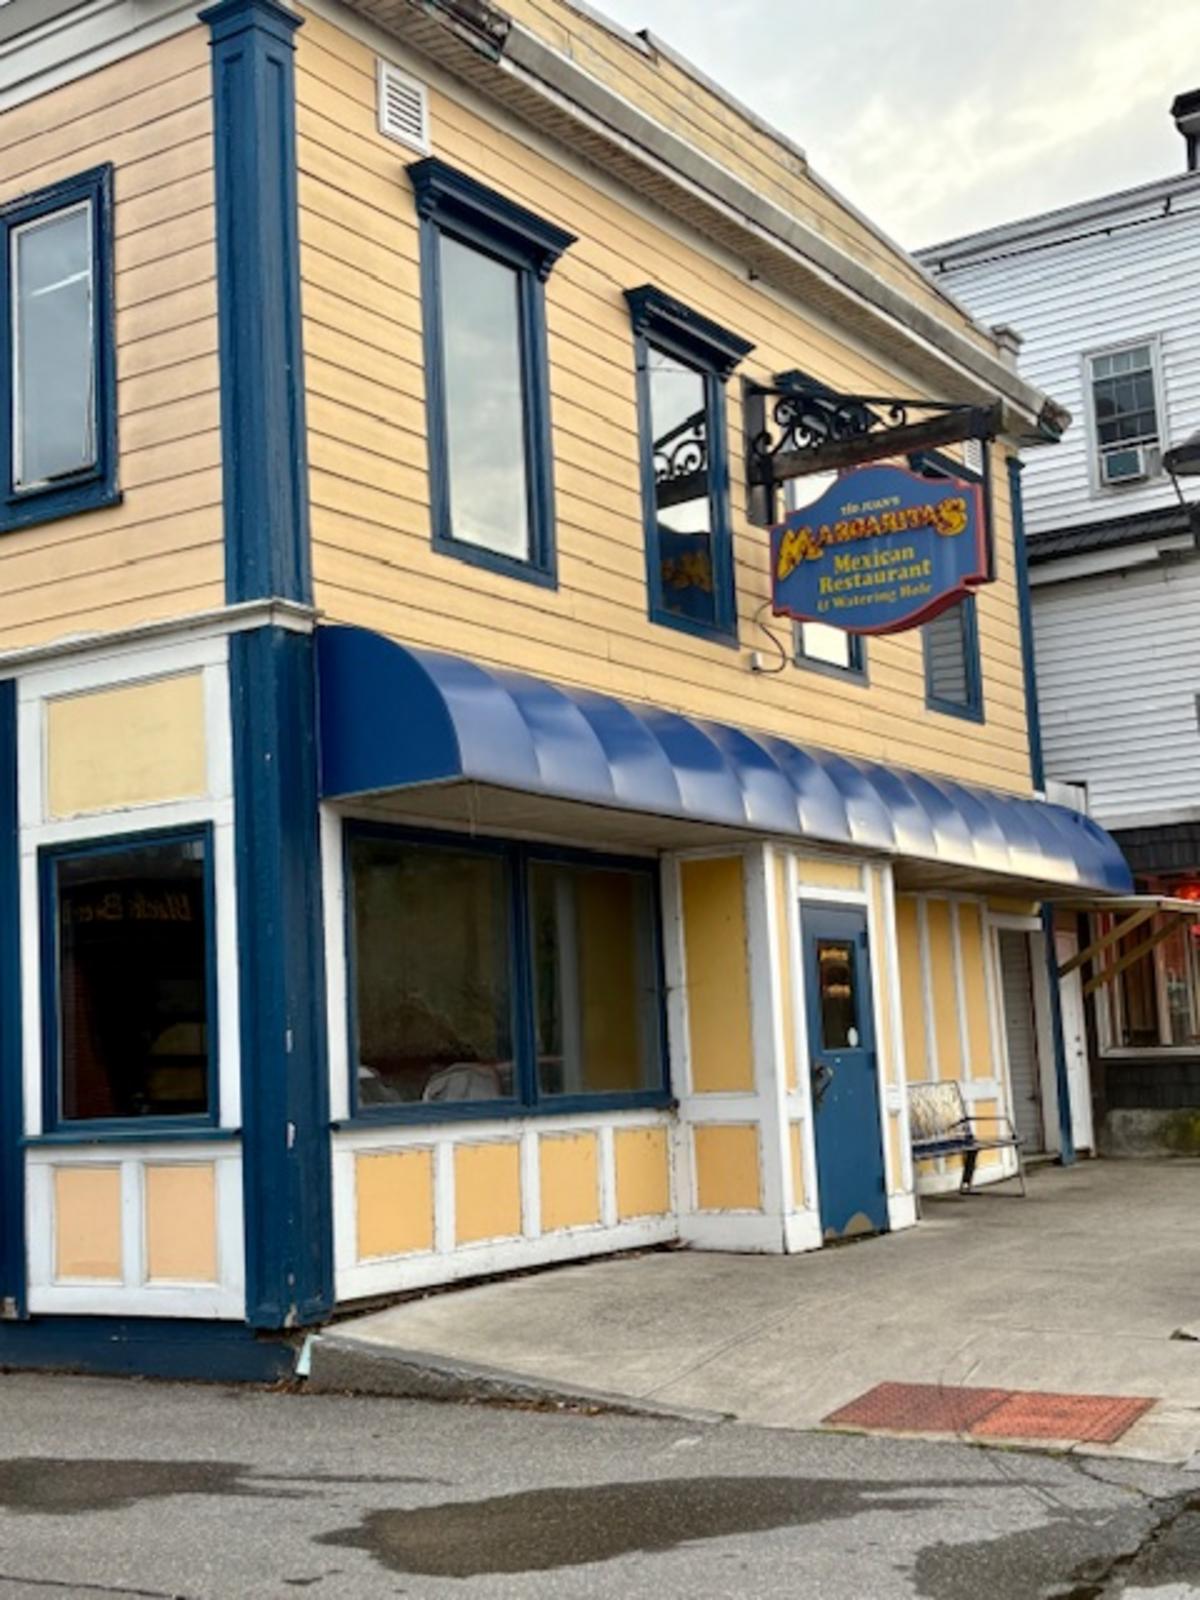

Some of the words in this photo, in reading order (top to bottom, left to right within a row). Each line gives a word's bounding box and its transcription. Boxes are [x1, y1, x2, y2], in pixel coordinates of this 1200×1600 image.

[776, 497, 968, 582] MARGARITAS
[833, 546, 915, 574] Mexican
[819, 559, 932, 594] Restaurant
[831, 591, 897, 609] Watering
[899, 582, 932, 598] Hole
